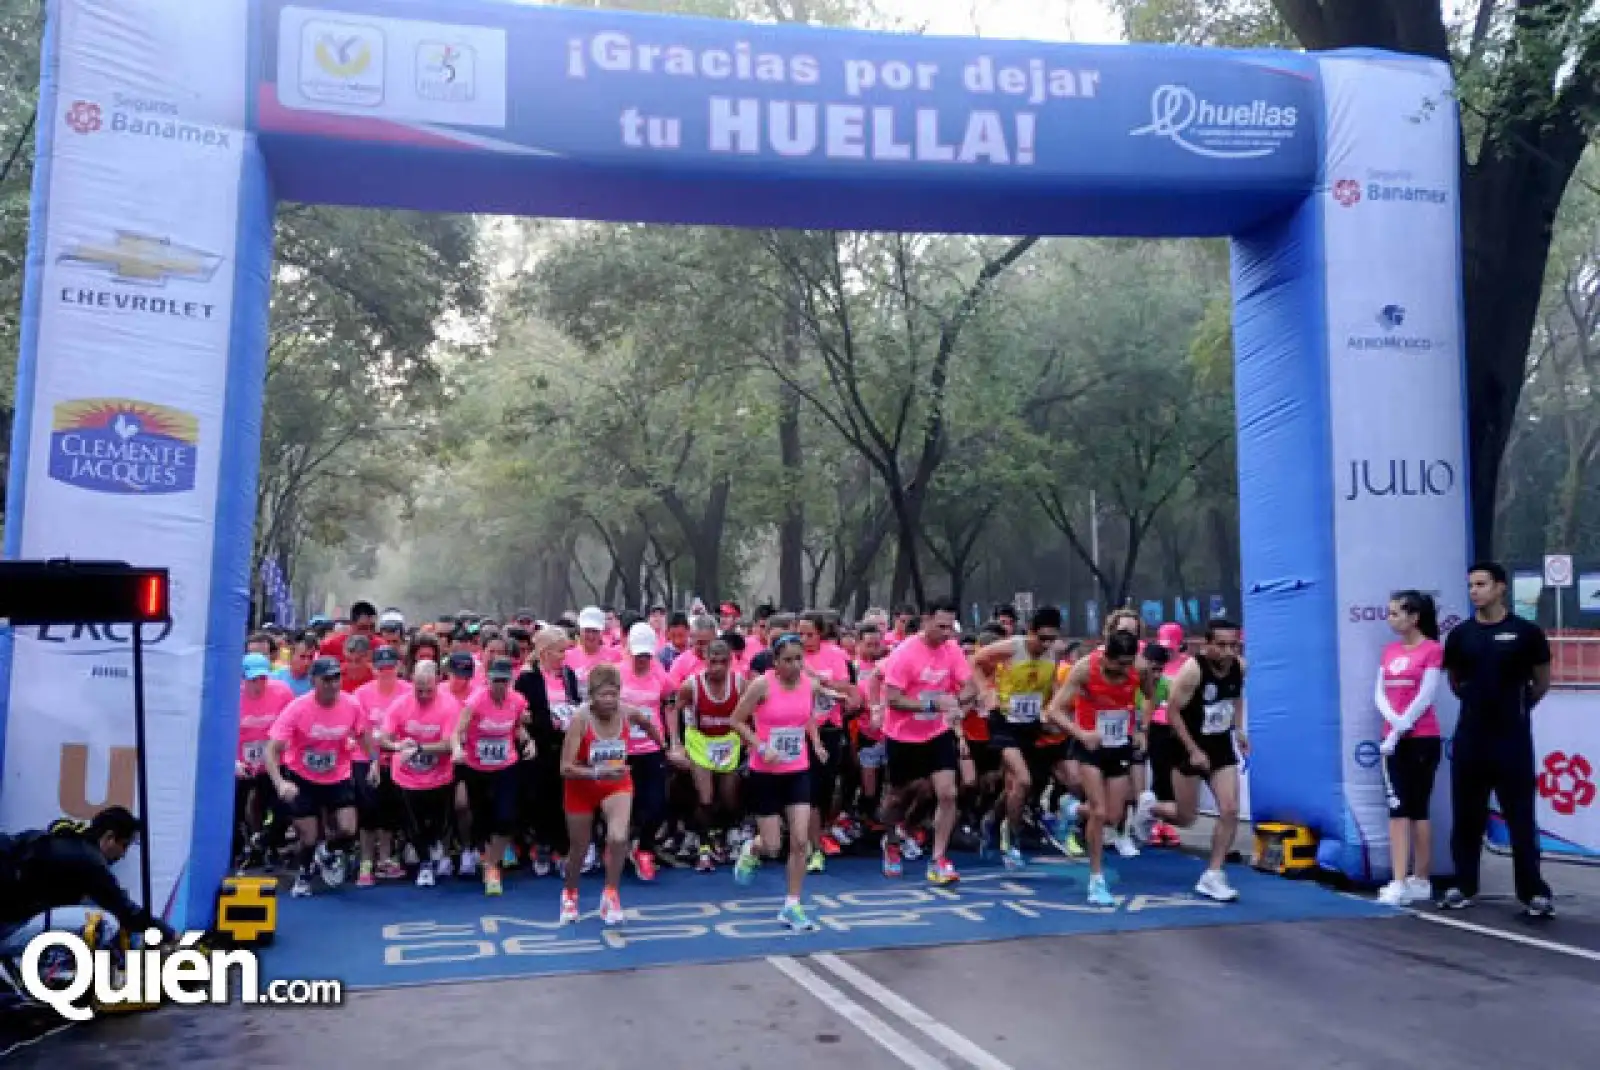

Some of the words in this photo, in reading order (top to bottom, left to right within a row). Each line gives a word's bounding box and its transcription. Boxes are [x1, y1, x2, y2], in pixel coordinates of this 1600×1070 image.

[566, 30, 820, 85] ¡Gracias
[844, 58, 939, 97] por
[963, 54, 1101, 104] dejar
[111, 111, 230, 148] Banamex
[1199, 99, 1298, 126] huellas
[620, 107, 681, 148] tu
[708, 96, 1037, 165] HUELLA!
[60, 287, 216, 319] CHEVROLET
[61, 434, 187, 466] CLEMENTE
[70, 456, 176, 488] JACQUES
[1345, 459, 1455, 500] JULIO
